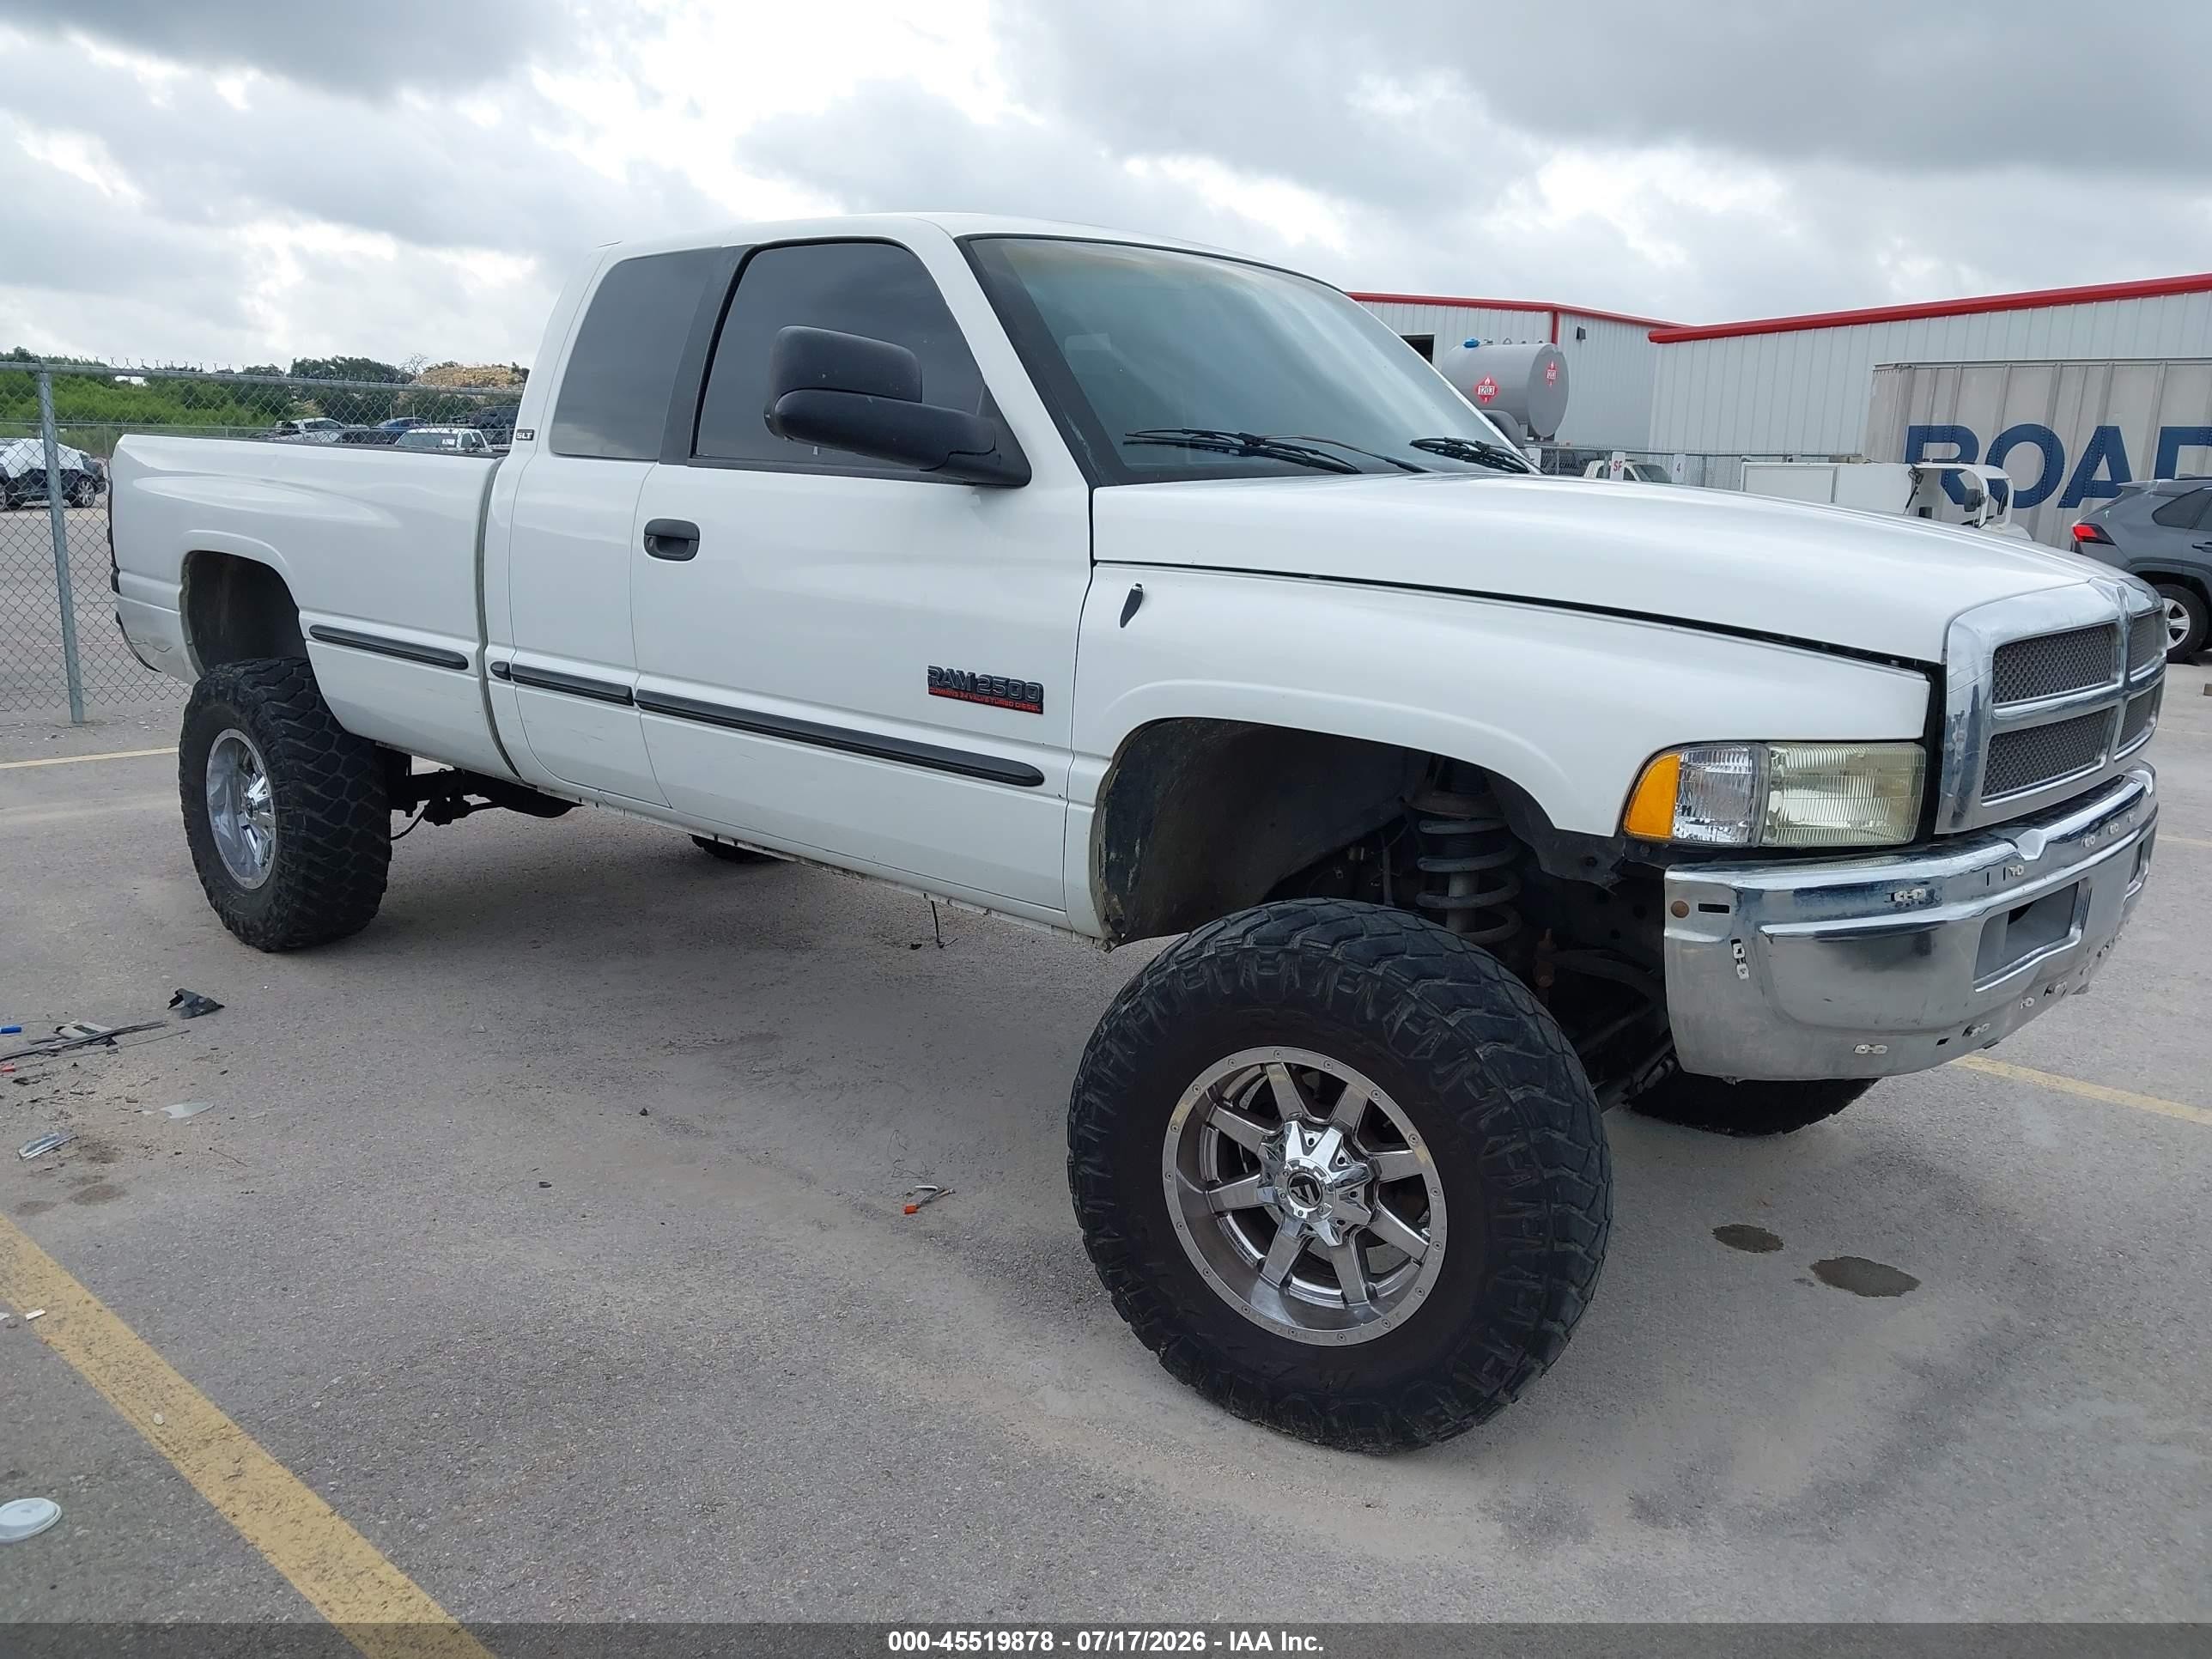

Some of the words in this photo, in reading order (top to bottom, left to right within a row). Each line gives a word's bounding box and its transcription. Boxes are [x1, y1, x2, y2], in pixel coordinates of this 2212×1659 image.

[1480, 386, 1494, 394] 1203
[1613, 460, 1623, 472] SF
[927, 665, 976, 691] RAM
[976, 674, 1044, 702] 2500
